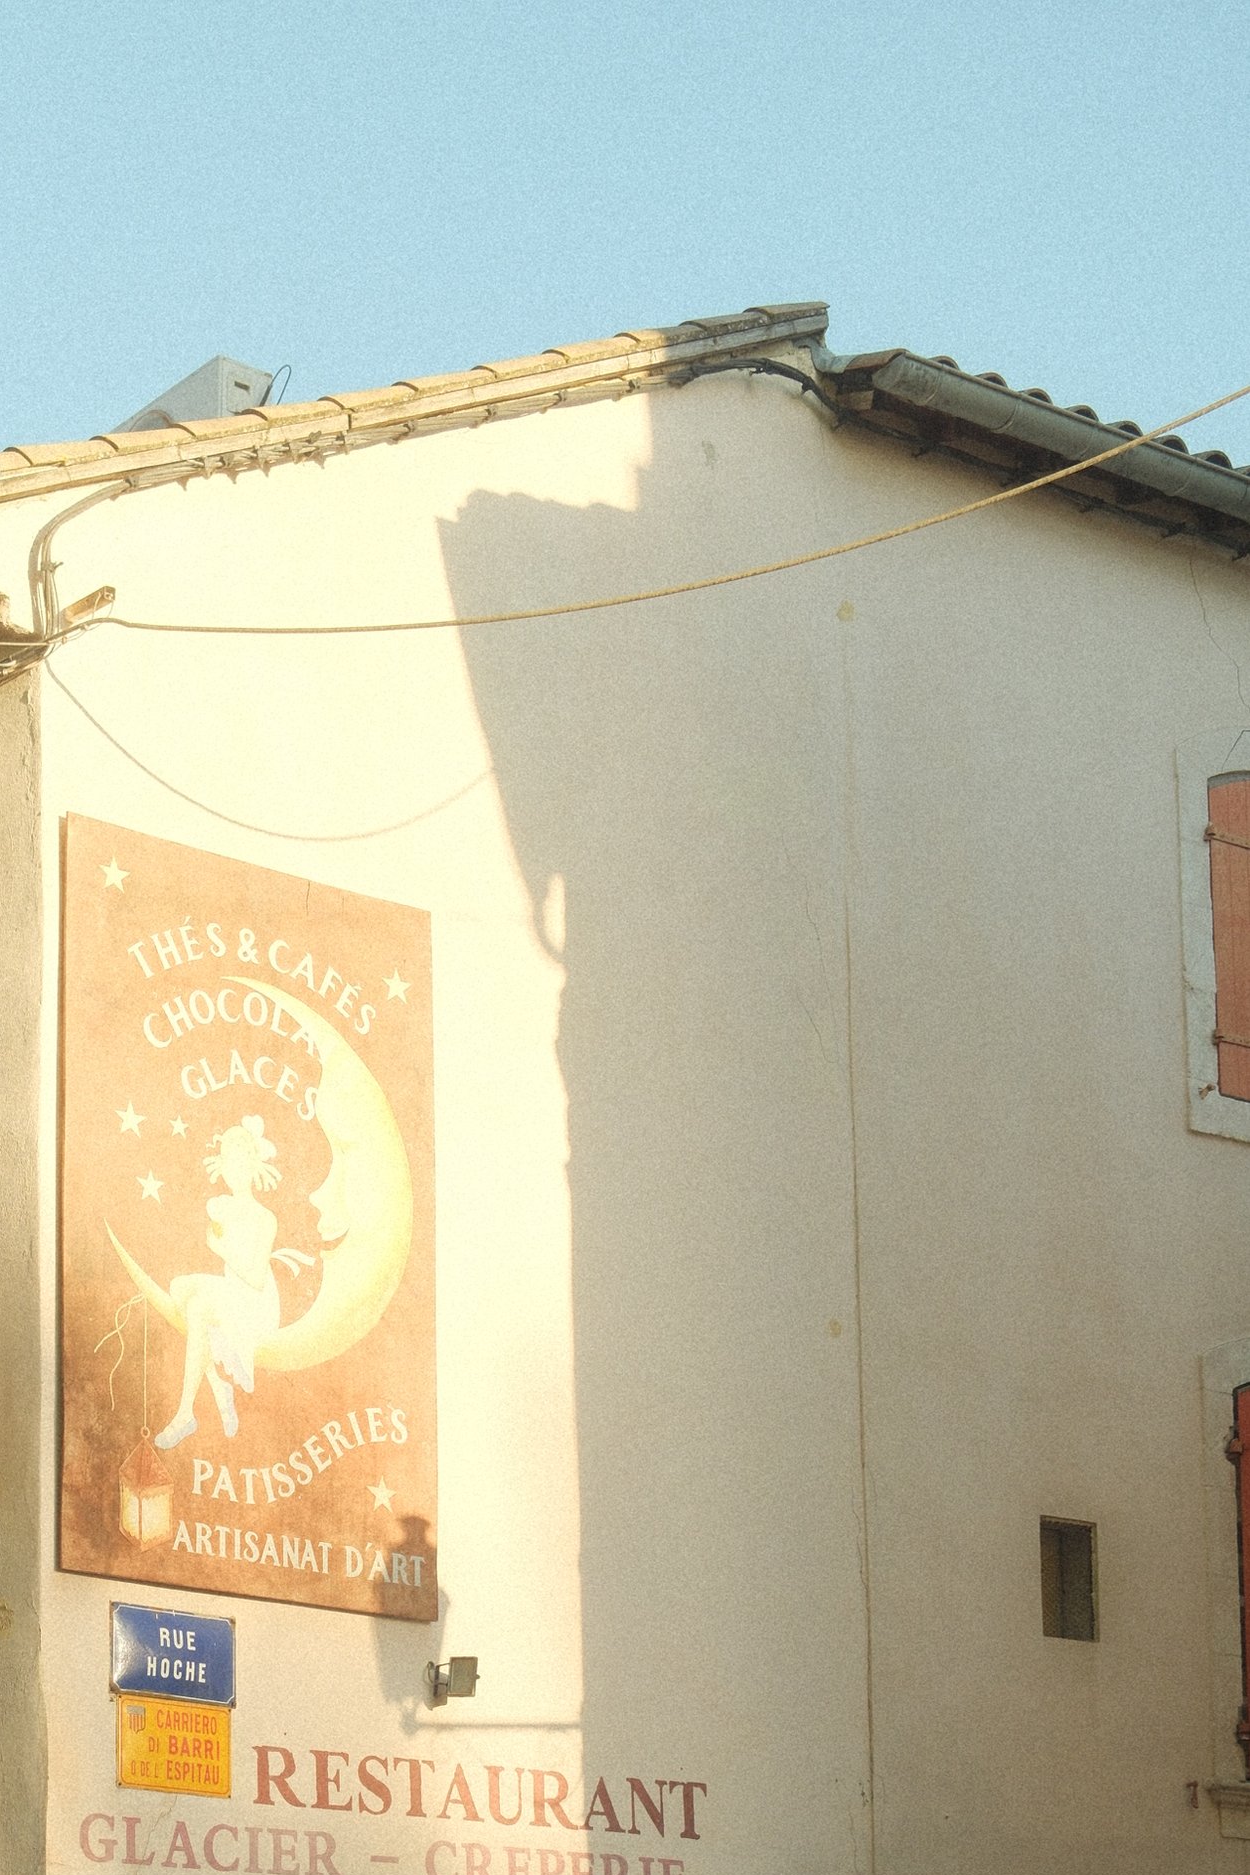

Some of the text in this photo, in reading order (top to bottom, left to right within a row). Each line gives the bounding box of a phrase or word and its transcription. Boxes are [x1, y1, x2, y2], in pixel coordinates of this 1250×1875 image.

[127, 915, 376, 1036] THÉS & CAFÉS
[180, 1049, 317, 1122] GLACES
[191, 1406, 409, 1506] PATISSERIES
[172, 1520, 426, 1587] ARTISANAT D'ART
[159, 1627, 196, 1651] RUE
[146, 1655, 207, 1684] HOCHE
[156, 1709, 218, 1736] CARRIERO
[148, 1734, 220, 1761] DI BARRI
[166, 1760, 220, 1785] ESPITAU
[251, 1744, 708, 1840] RESTAURANT
